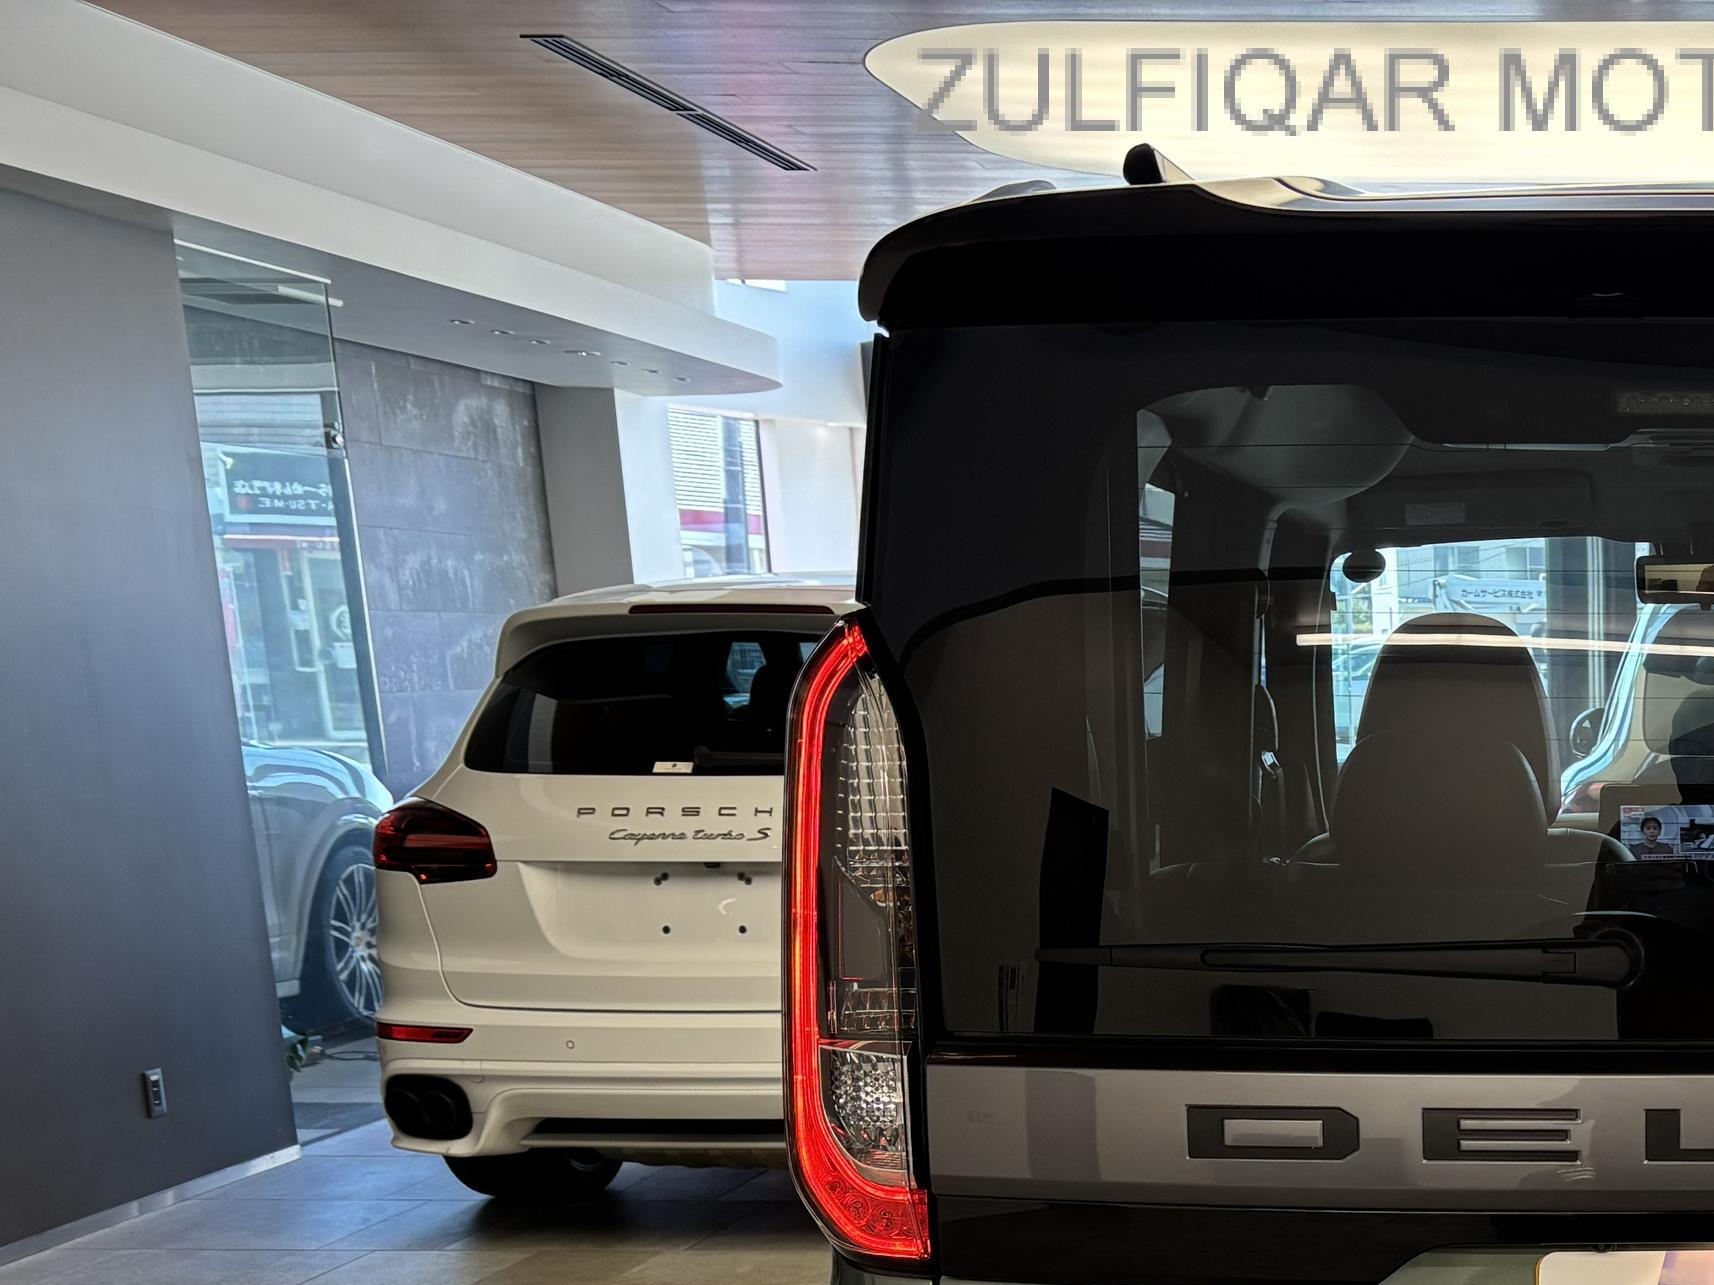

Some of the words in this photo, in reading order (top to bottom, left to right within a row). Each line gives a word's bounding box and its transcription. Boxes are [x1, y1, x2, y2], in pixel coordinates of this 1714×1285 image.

[608, 828, 688, 846] Cayenne
[692, 829, 746, 842] turbo
[746, 827, 772, 841] S
